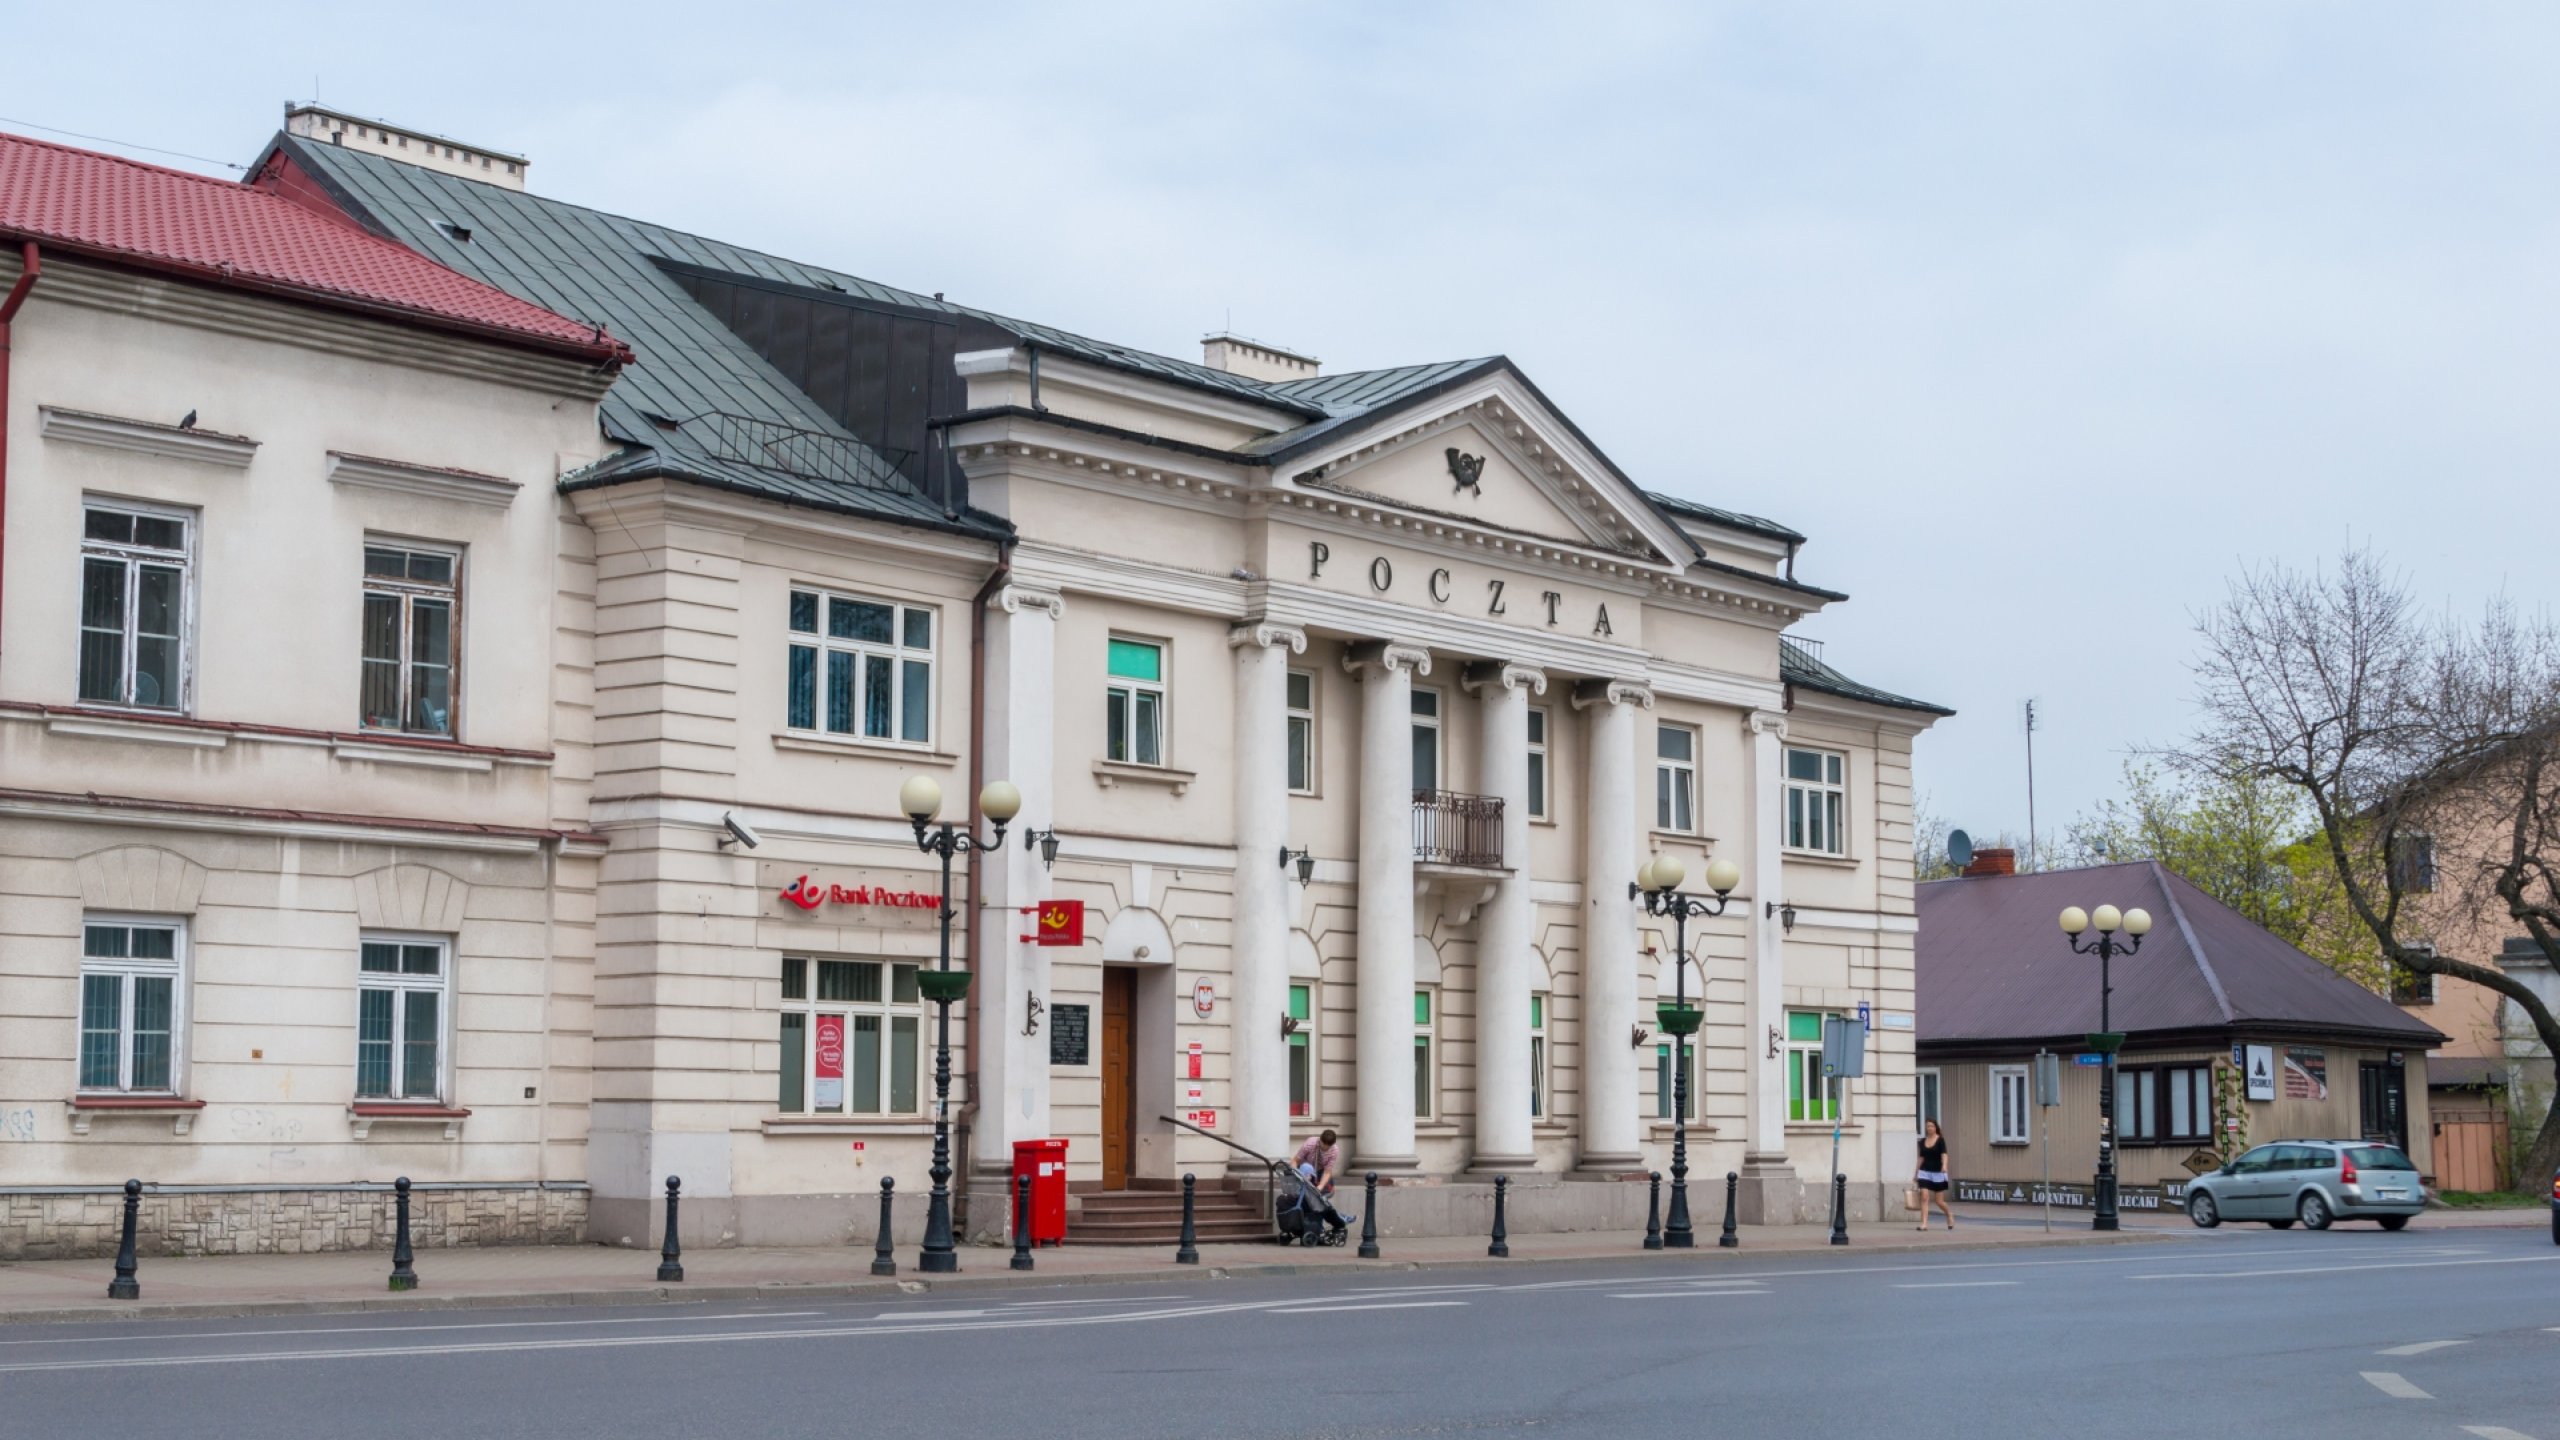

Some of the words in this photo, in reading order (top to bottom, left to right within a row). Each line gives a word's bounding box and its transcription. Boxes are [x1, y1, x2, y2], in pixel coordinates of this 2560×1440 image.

[1310, 541, 1613, 635] POCZTA
[831, 884, 870, 905] Bank
[1960, 1188, 2005, 1202] LATARKI
[2032, 1191, 2083, 1206] LORNETKI
[2118, 1194, 2159, 1208] LECAKI
